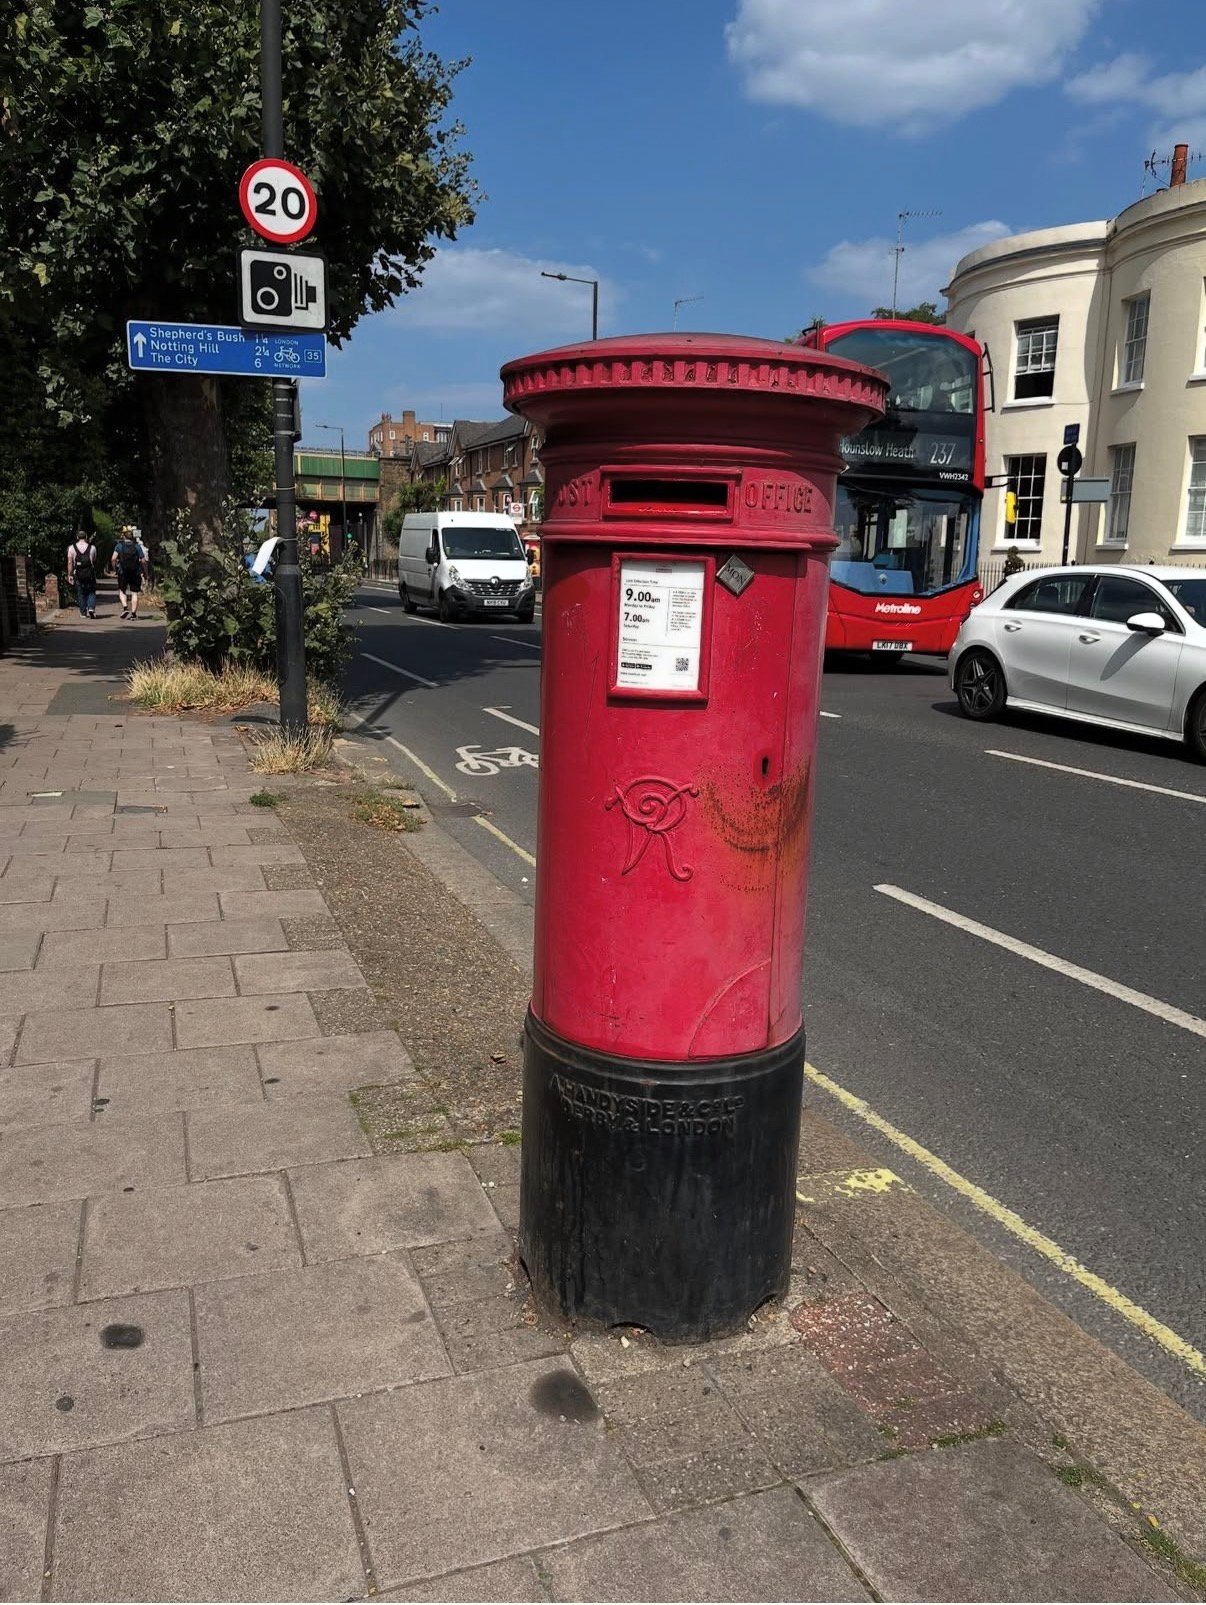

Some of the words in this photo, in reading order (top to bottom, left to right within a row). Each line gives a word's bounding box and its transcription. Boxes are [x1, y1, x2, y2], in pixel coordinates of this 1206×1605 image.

[253, 182, 306, 220] 20
[150, 327, 213, 342] Shepherd's
[217, 331, 245, 343] Bush
[150, 340, 195, 353] Notting
[199, 342, 220, 354] Hill
[150, 352, 172, 363] The
[175, 353, 199, 366] City
[254, 358, 262, 368] 6
[306, 352, 320, 361] 35
[885, 442, 914, 459] Heath
[930, 442, 956, 465] 237
[939, 472, 969, 481] VWH2342
[745, 482, 813, 513] OFFICE
[726, 563, 747, 586] MON
[874, 602, 922, 615] Metroline
[647, 1115, 737, 1135] LONDON
